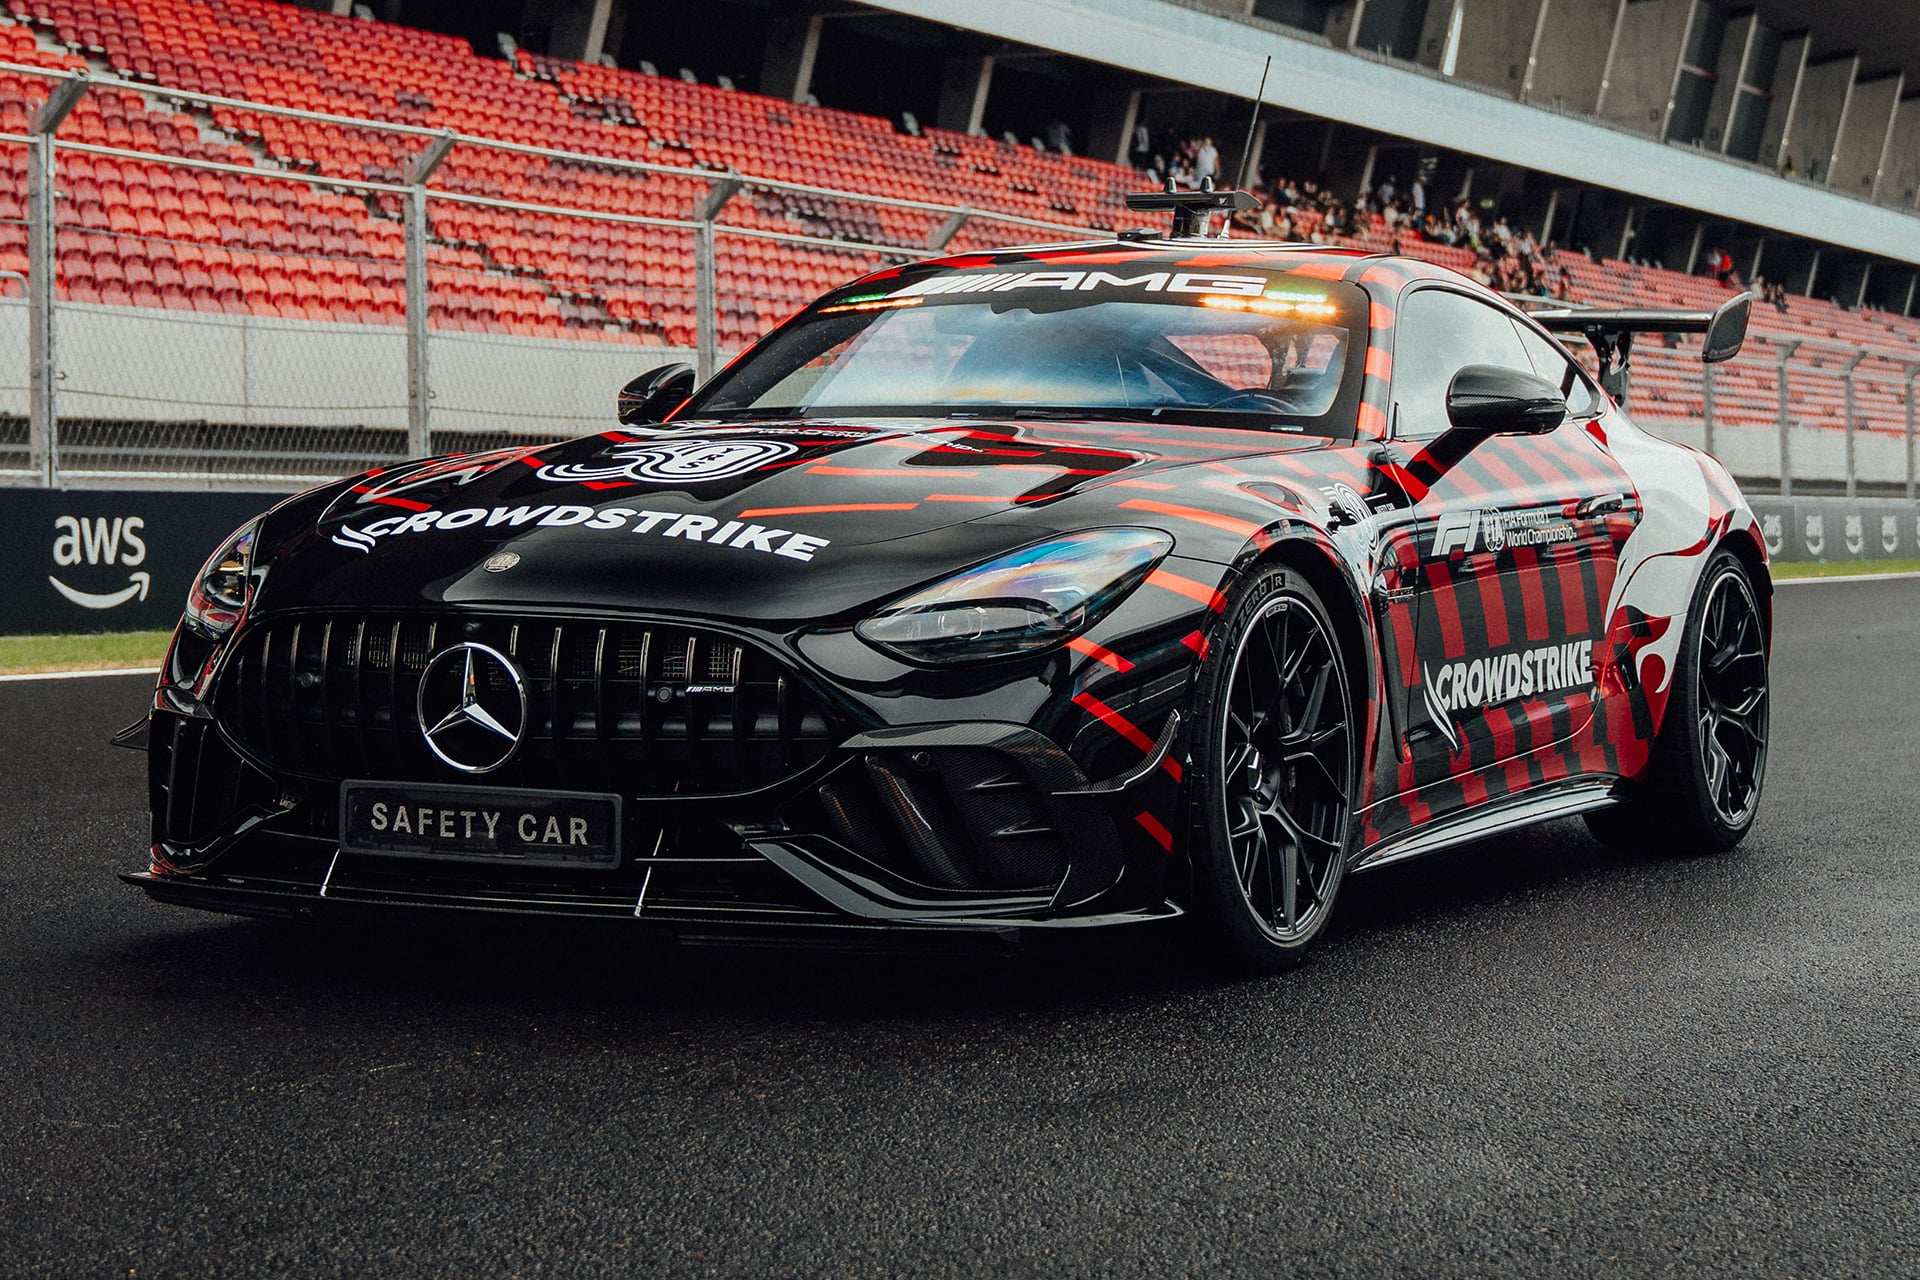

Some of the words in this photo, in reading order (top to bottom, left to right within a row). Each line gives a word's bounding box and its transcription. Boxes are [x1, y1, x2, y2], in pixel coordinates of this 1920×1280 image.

[999, 271, 1267, 297] AMG
[53, 515, 146, 567] aws
[359, 504, 831, 563] CROWDSTRIKE
[1431, 509, 1482, 556] F1
[1506, 529, 1527, 547] World
[701, 685, 736, 693] AMG
[1435, 639, 1593, 711] CROWDSTRIKE
[370, 802, 501, 839] SAFETY
[517, 813, 589, 846] CAR
